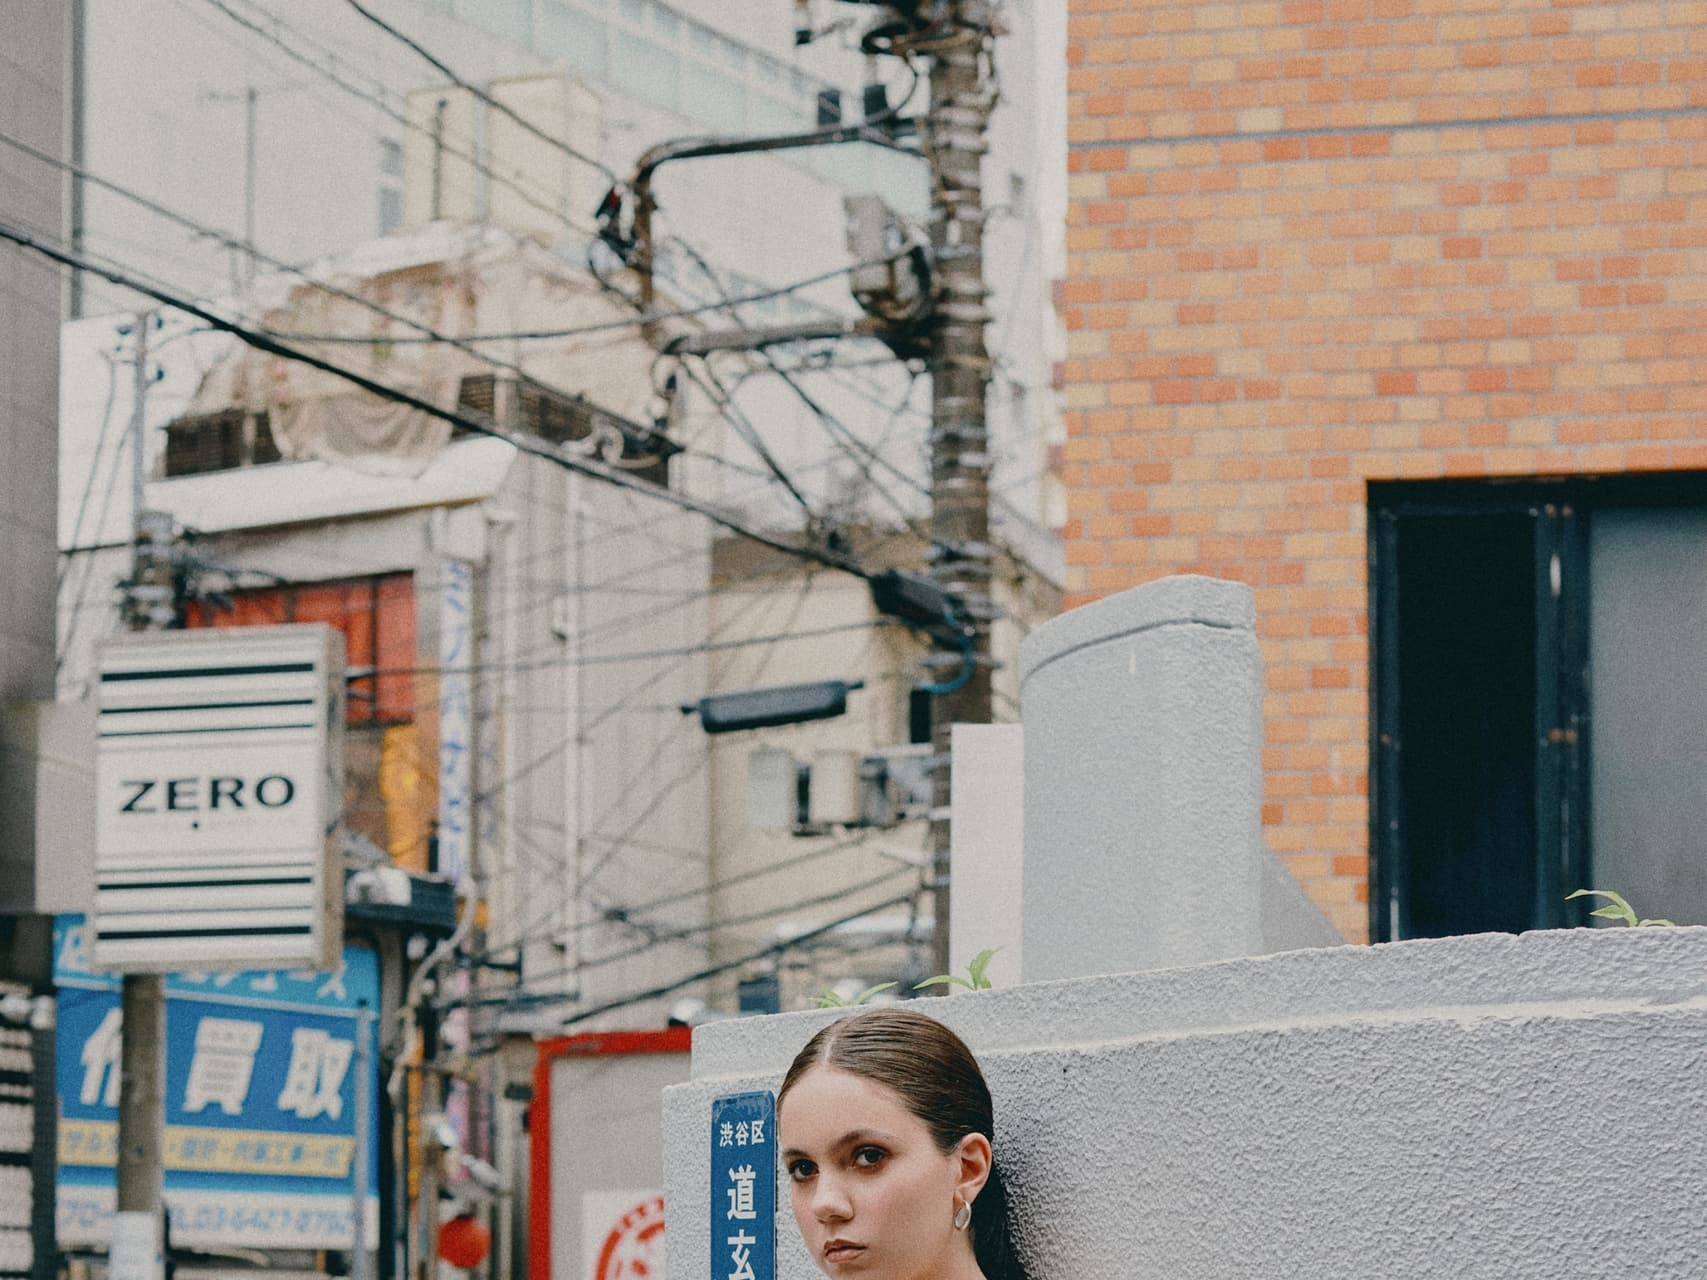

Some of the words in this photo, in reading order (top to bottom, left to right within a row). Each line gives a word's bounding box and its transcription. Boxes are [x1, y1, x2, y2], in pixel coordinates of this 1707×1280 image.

[120, 776, 294, 812] ZERO
[719, 1120, 765, 1147] 渋谷区
